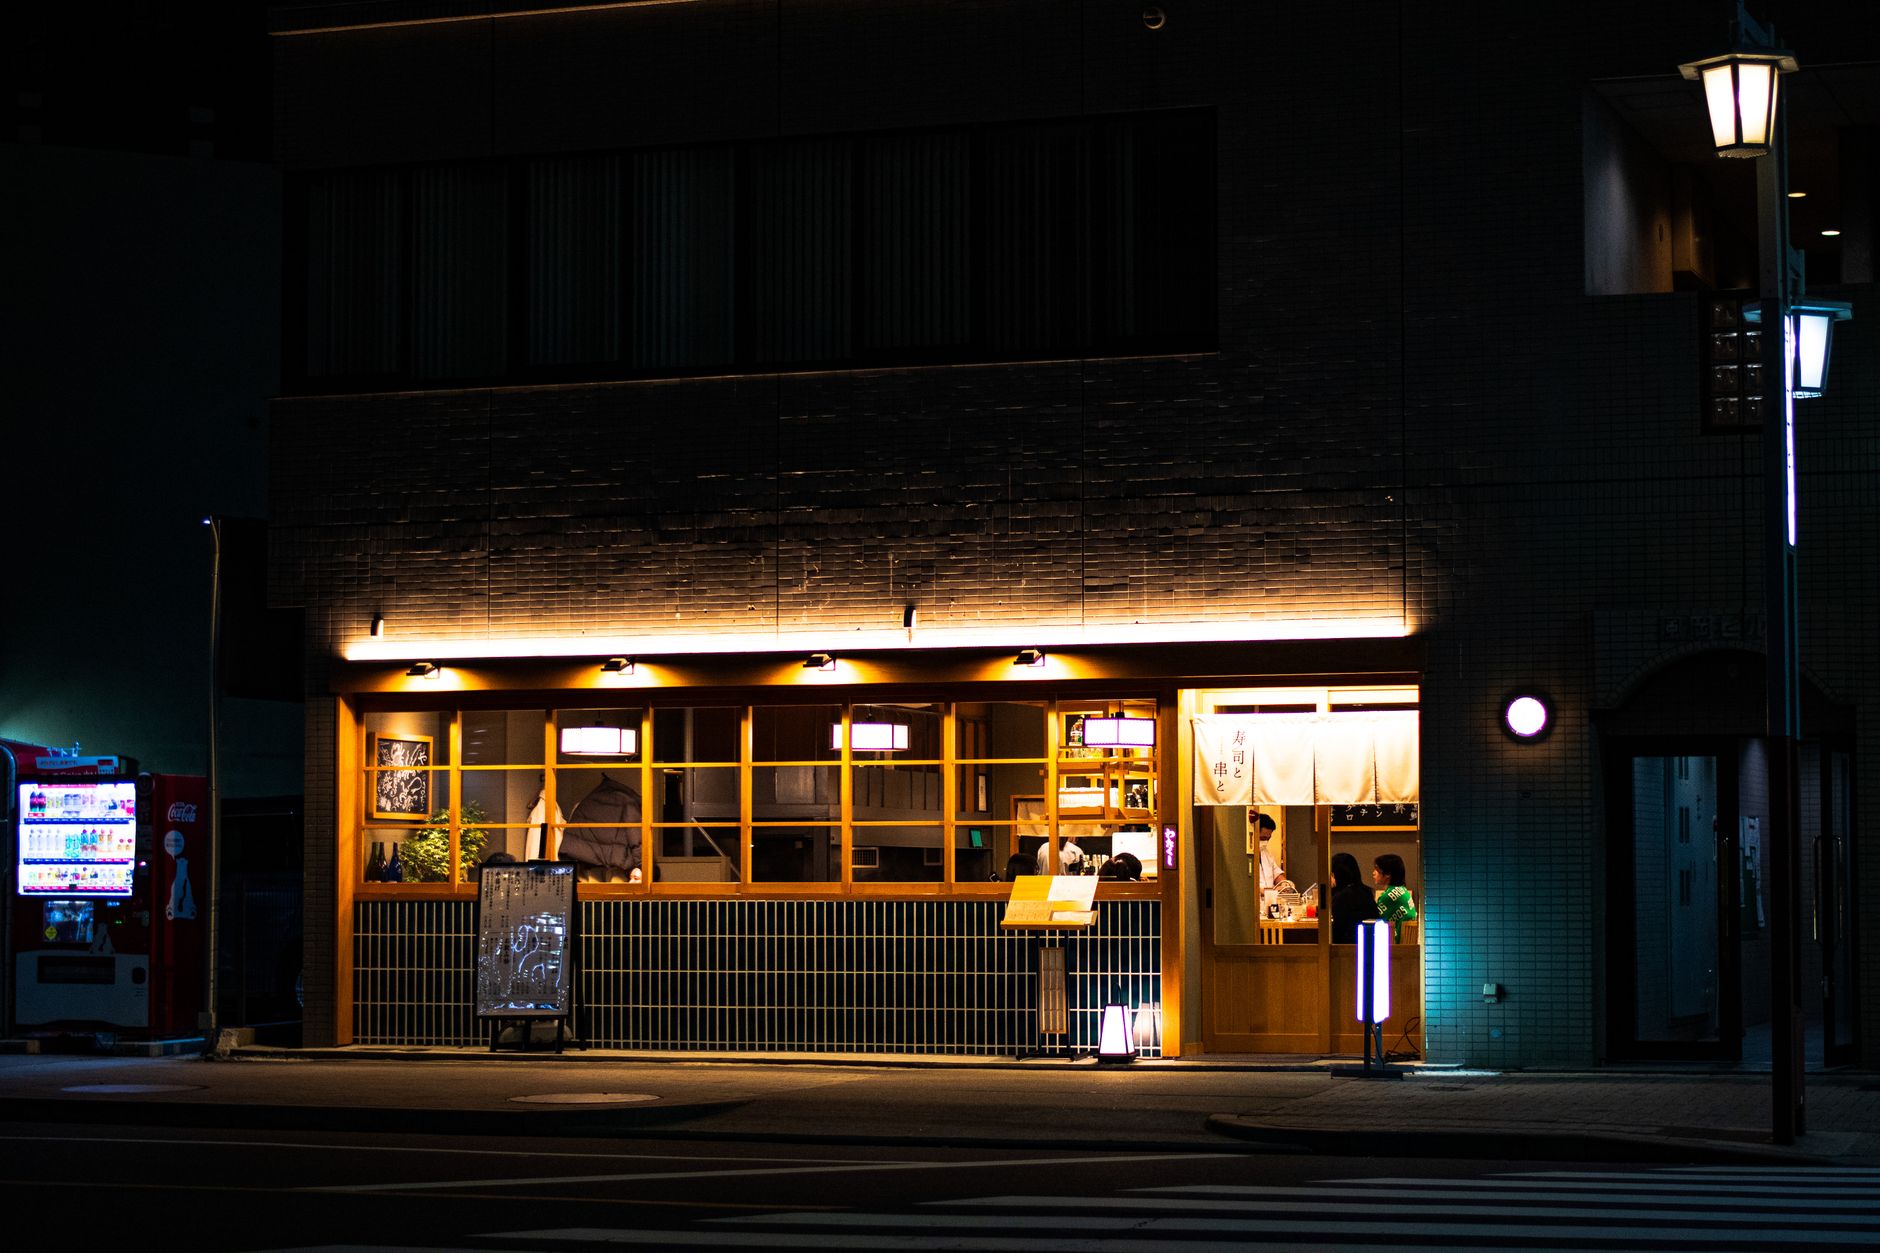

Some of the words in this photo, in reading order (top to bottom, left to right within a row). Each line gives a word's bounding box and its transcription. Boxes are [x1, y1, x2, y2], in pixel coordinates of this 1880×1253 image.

[1232, 729, 1246, 779] 寿司と
[1213, 761, 1228, 792] 串と
